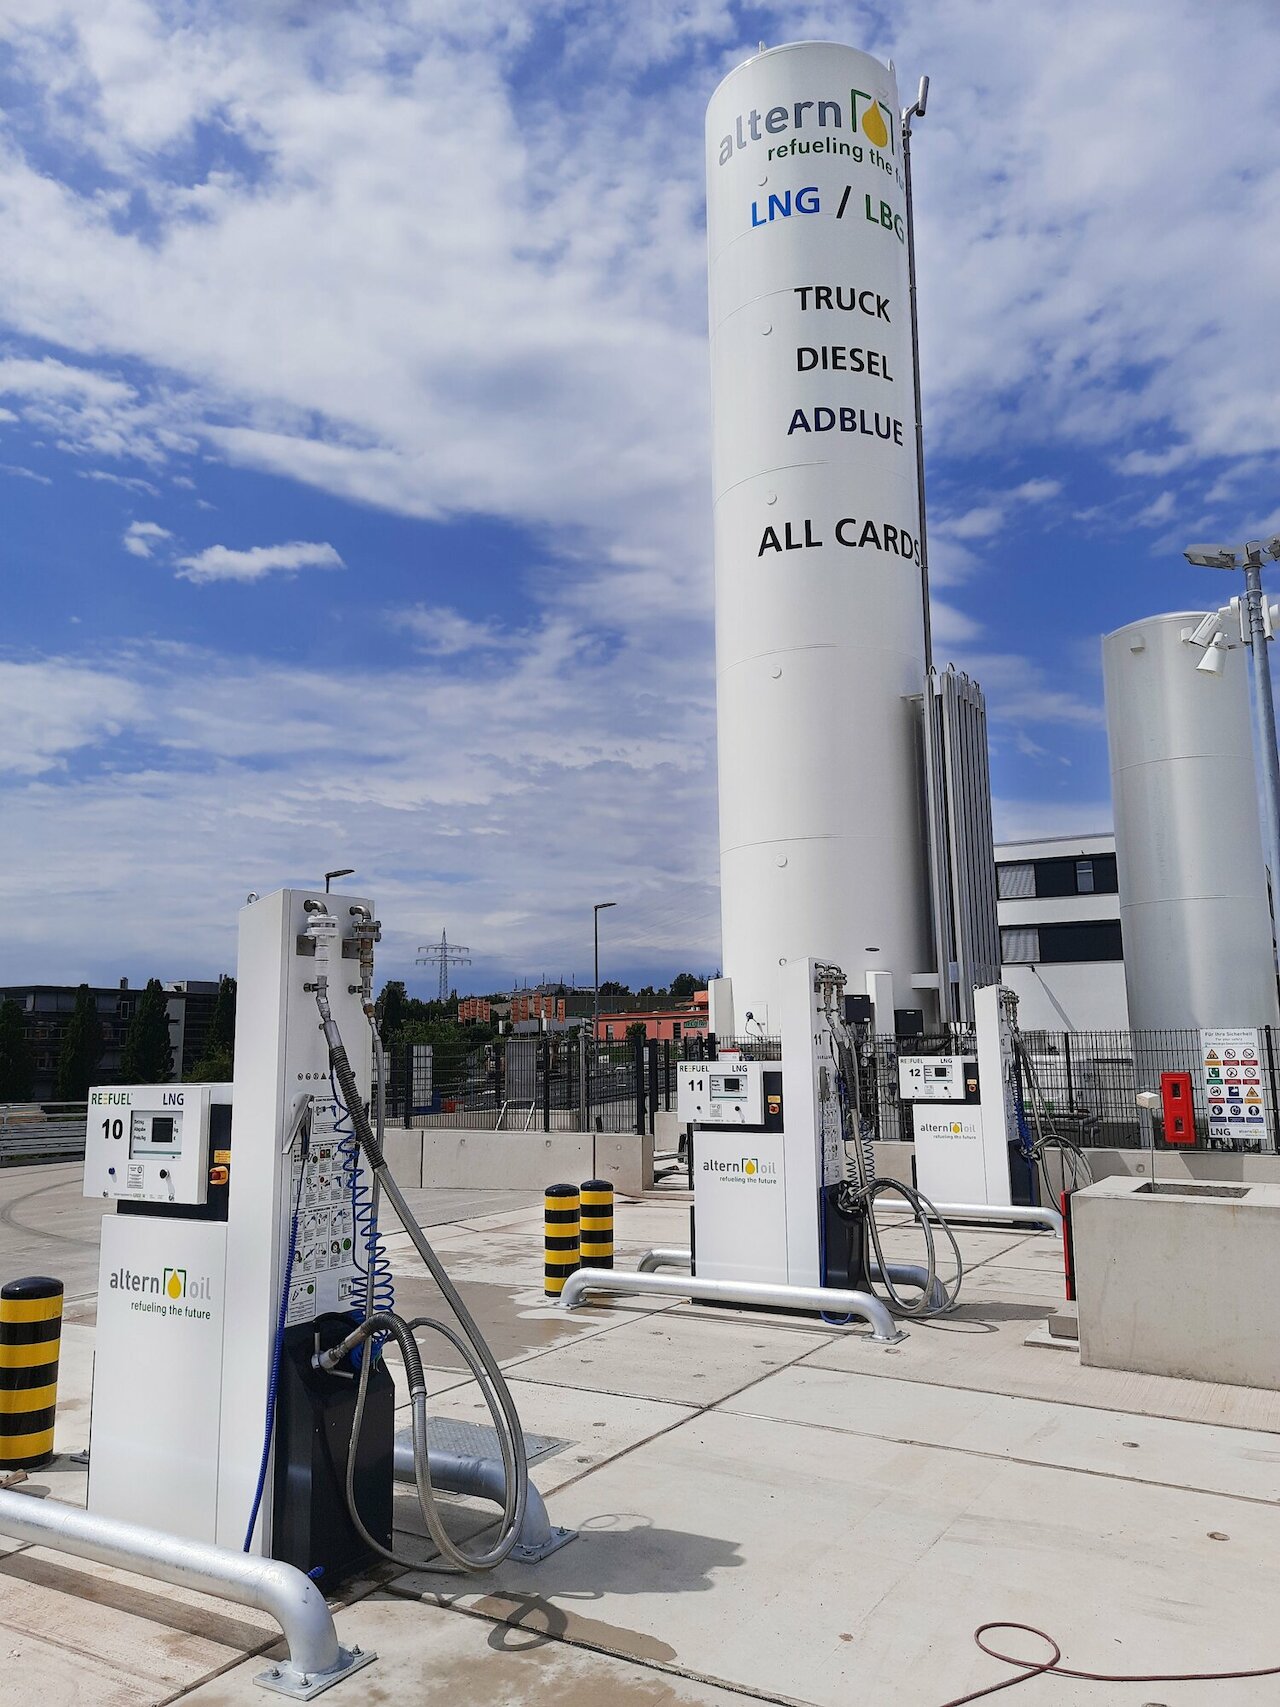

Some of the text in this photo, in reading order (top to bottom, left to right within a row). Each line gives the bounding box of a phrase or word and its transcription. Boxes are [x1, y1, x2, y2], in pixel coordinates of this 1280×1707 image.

[768, 137, 863, 162] refueling
[869, 149, 893, 175] the
[751, 185, 905, 244] LNG / LBG
[794, 286, 891, 323] TRUCK
[797, 346, 893, 382] DIESEL
[787, 407, 904, 446] ADBLUE
[758, 518, 920, 567] ALL CARDS
[814, 1034, 823, 1046] 11
[731, 1065, 748, 1073] LNG
[908, 1068, 921, 1077] 12
[688, 1079, 703, 1092] 11
[162, 1093, 184, 1106] LNG
[102, 1118, 124, 1140] 10
[1210, 1128, 1231, 1136] LNG
[703, 1159, 740, 1173] altern
[719, 1175, 746, 1184] refueling
[758, 1177, 777, 1185] future
[110, 1268, 160, 1294] altern
[131, 1300, 211, 1320] refueling the future
